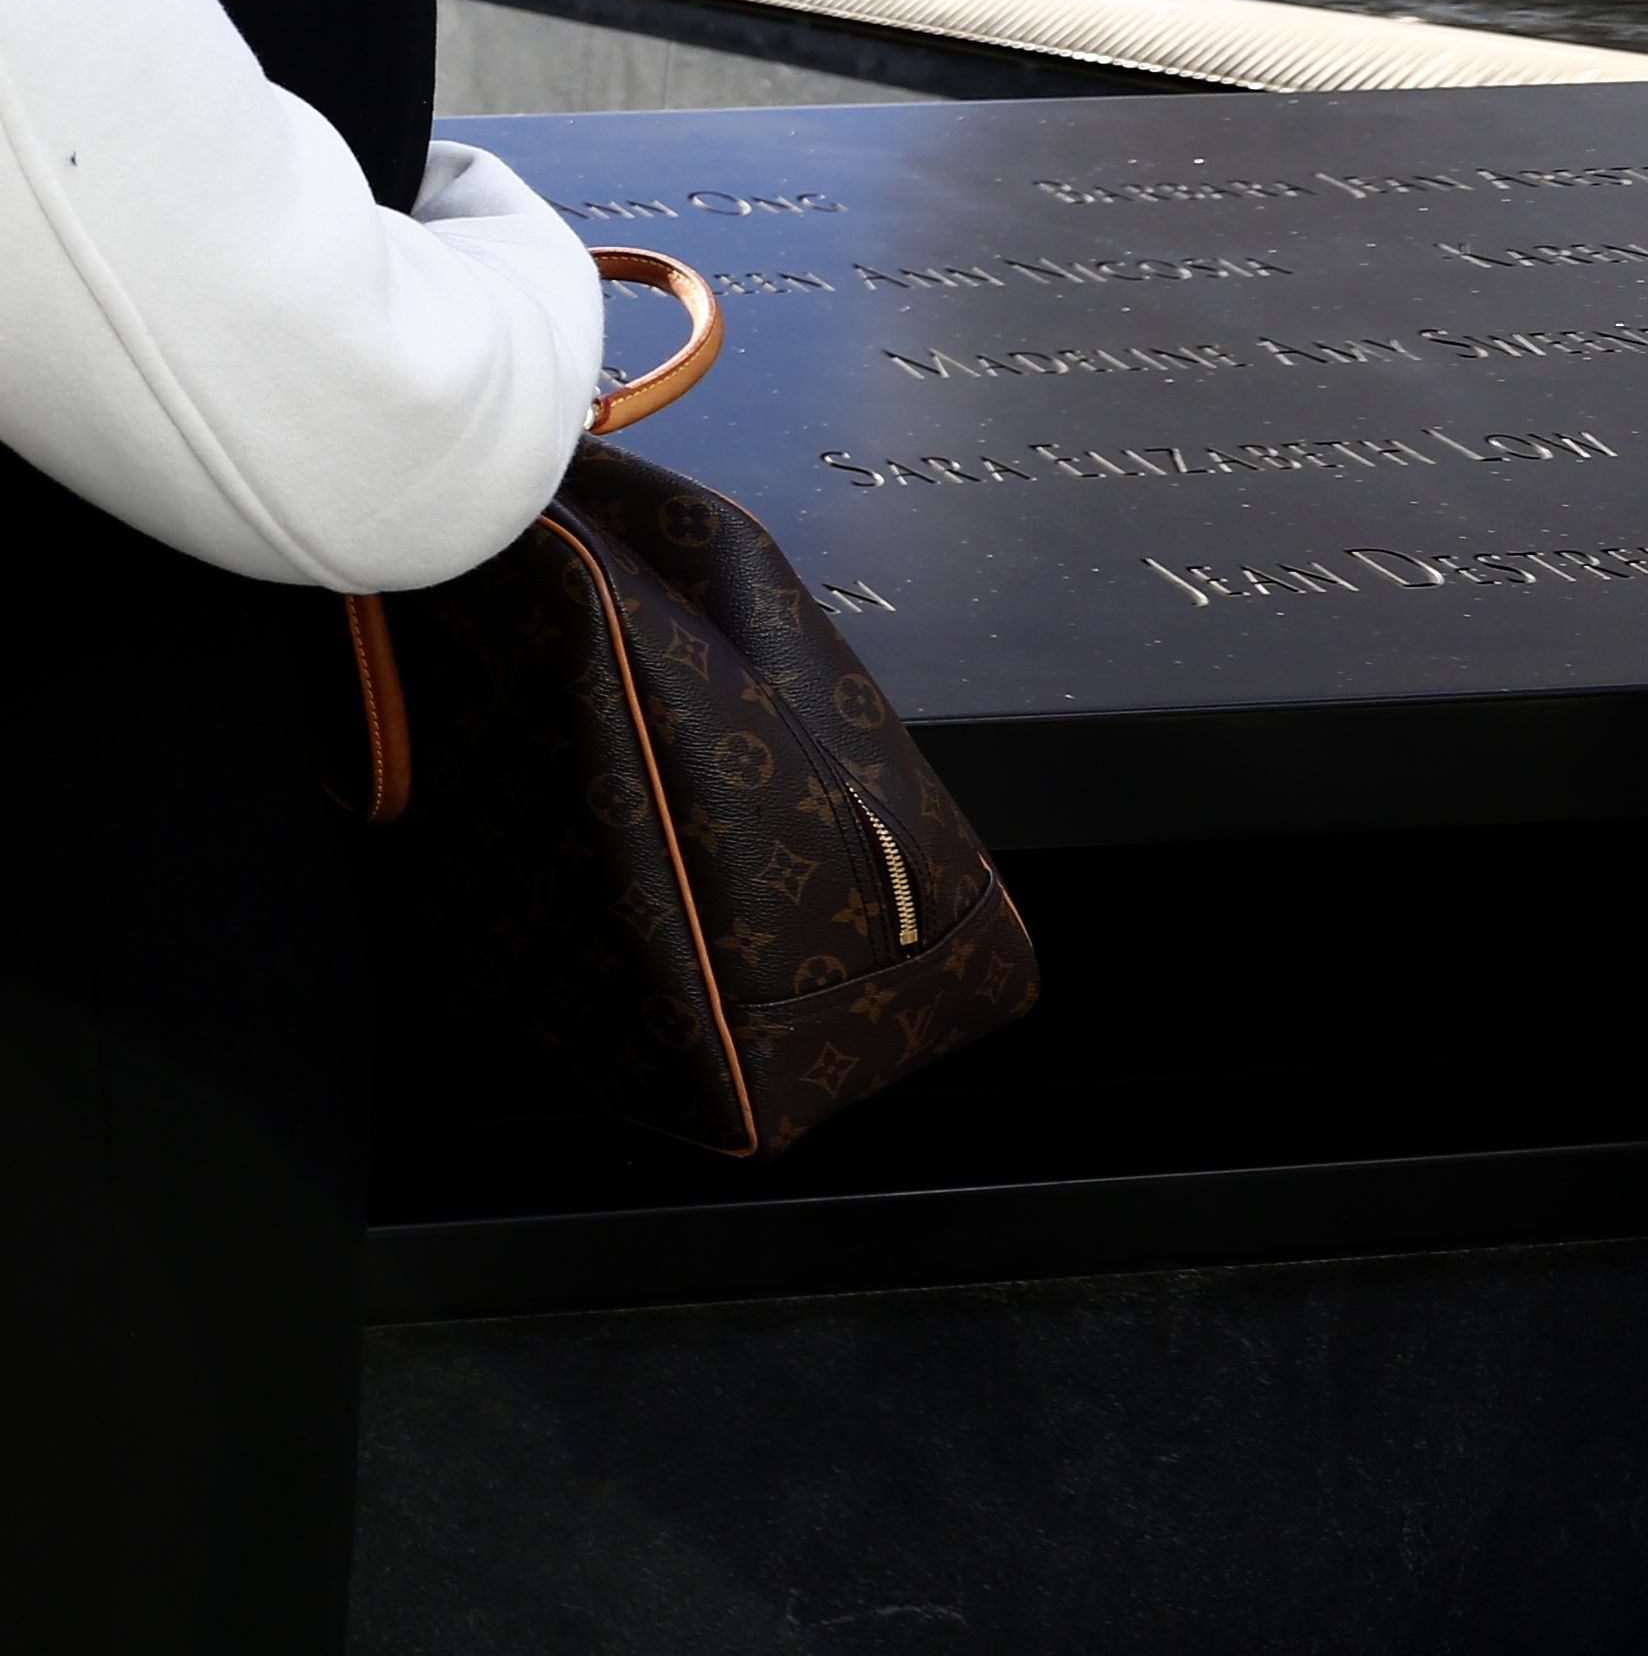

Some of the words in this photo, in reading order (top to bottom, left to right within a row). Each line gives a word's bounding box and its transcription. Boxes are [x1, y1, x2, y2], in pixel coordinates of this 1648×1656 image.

[688, 190, 848, 217] ONG
[1033, 180, 1319, 205] BARBARA
[1312, 172, 1474, 199] JEAN
[1475, 165, 1648, 190] AREST
[852, 262, 1005, 291] ANN
[1003, 256, 1295, 285] NICOSIA
[881, 344, 1252, 380] MADELINE
[1257, 335, 1422, 367] AMY
[1417, 327, 1648, 359] SWEEN
[819, 450, 1038, 488] SARA
[1028, 440, 1437, 479] ELIZABETH
[1421, 427, 1619, 463] LOW
[1139, 557, 1359, 607] JEAN
[1344, 546, 1648, 588] DESTRE
